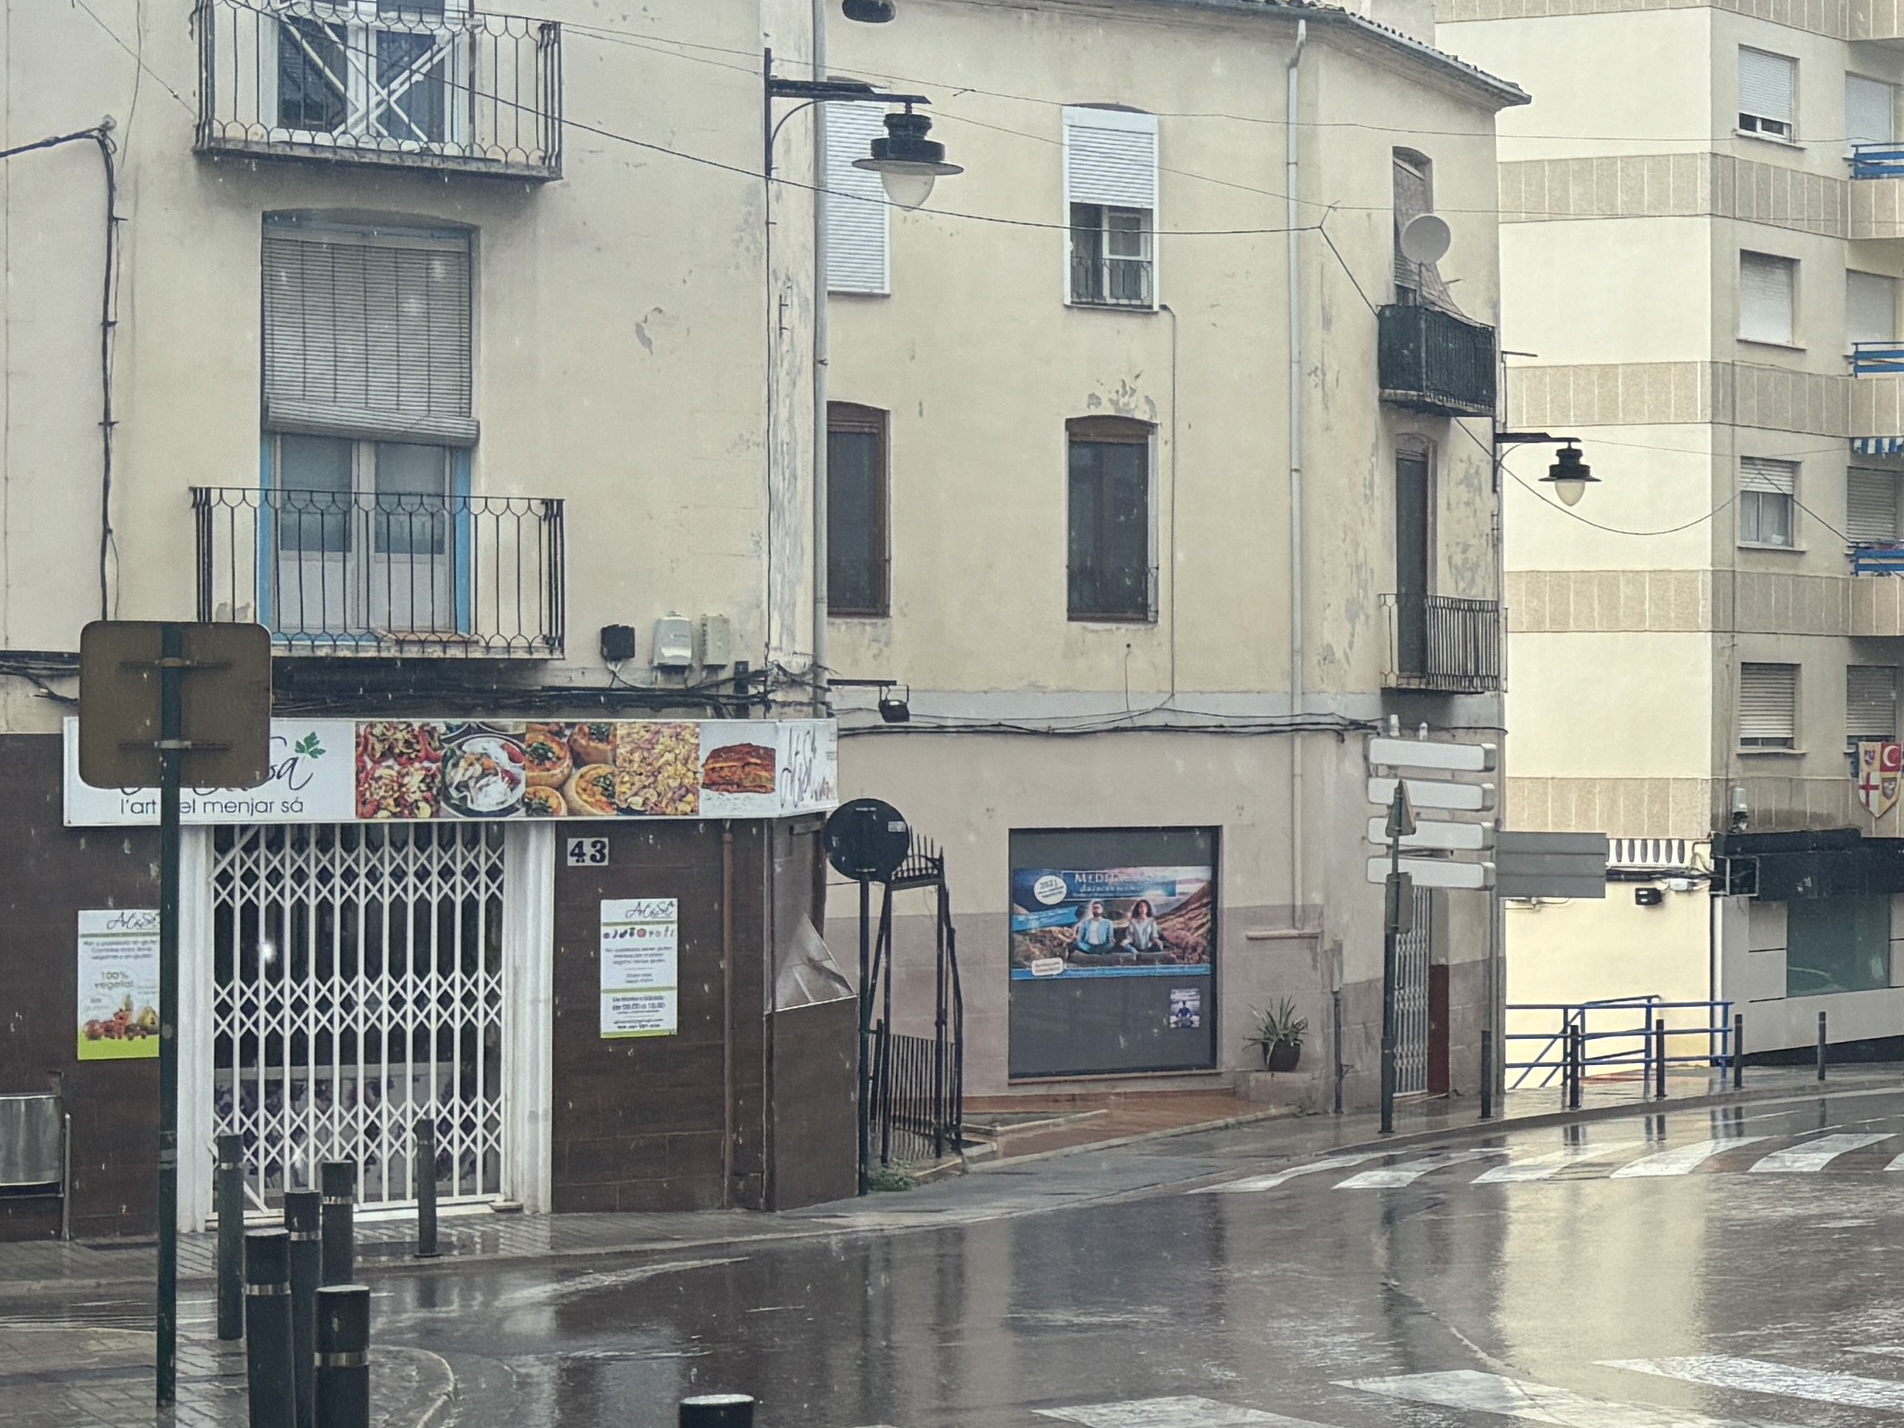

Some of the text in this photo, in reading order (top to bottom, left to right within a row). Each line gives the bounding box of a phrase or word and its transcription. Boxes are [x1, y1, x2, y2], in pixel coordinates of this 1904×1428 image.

[120, 798, 158, 814] l'art
[203, 798, 275, 817] menjar
[569, 839, 607, 864] 43
